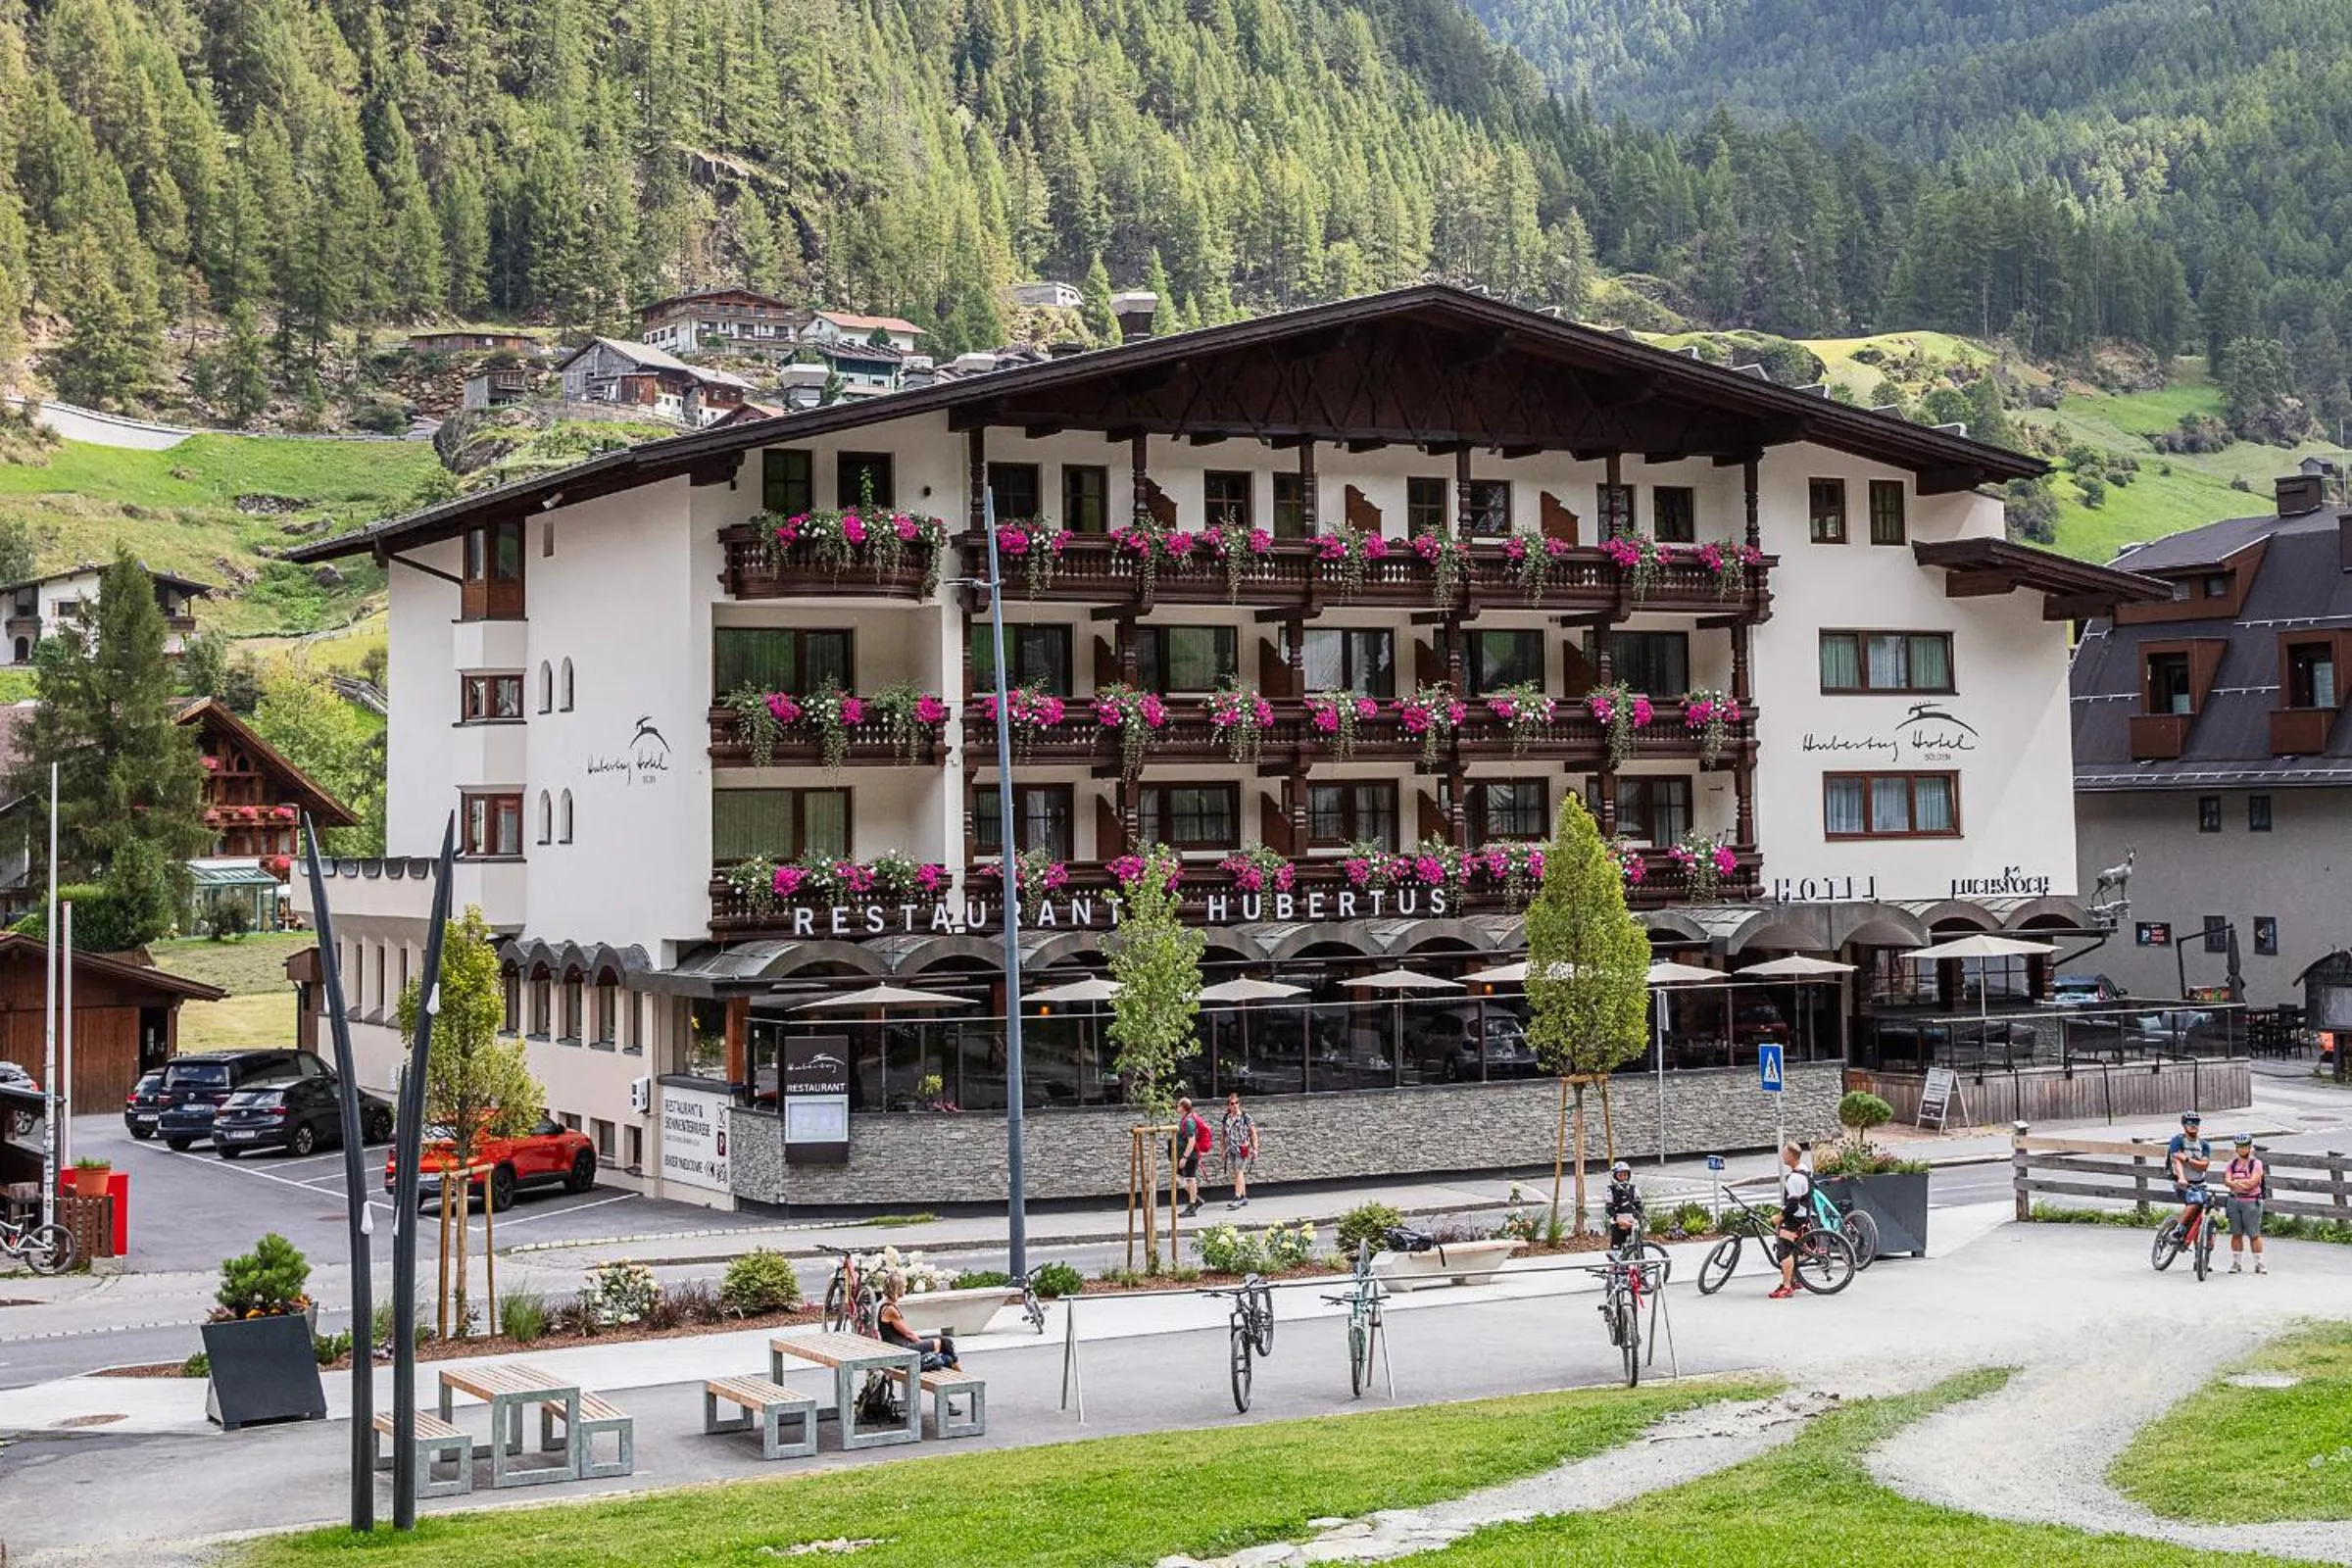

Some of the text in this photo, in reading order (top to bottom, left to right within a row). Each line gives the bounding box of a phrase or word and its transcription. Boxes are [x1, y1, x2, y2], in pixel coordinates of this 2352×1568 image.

[1912, 730, 1976, 751] Hotel
[1206, 888, 1446, 921] HUBERTUS
[786, 1082, 846, 1093] RESTAURANT
